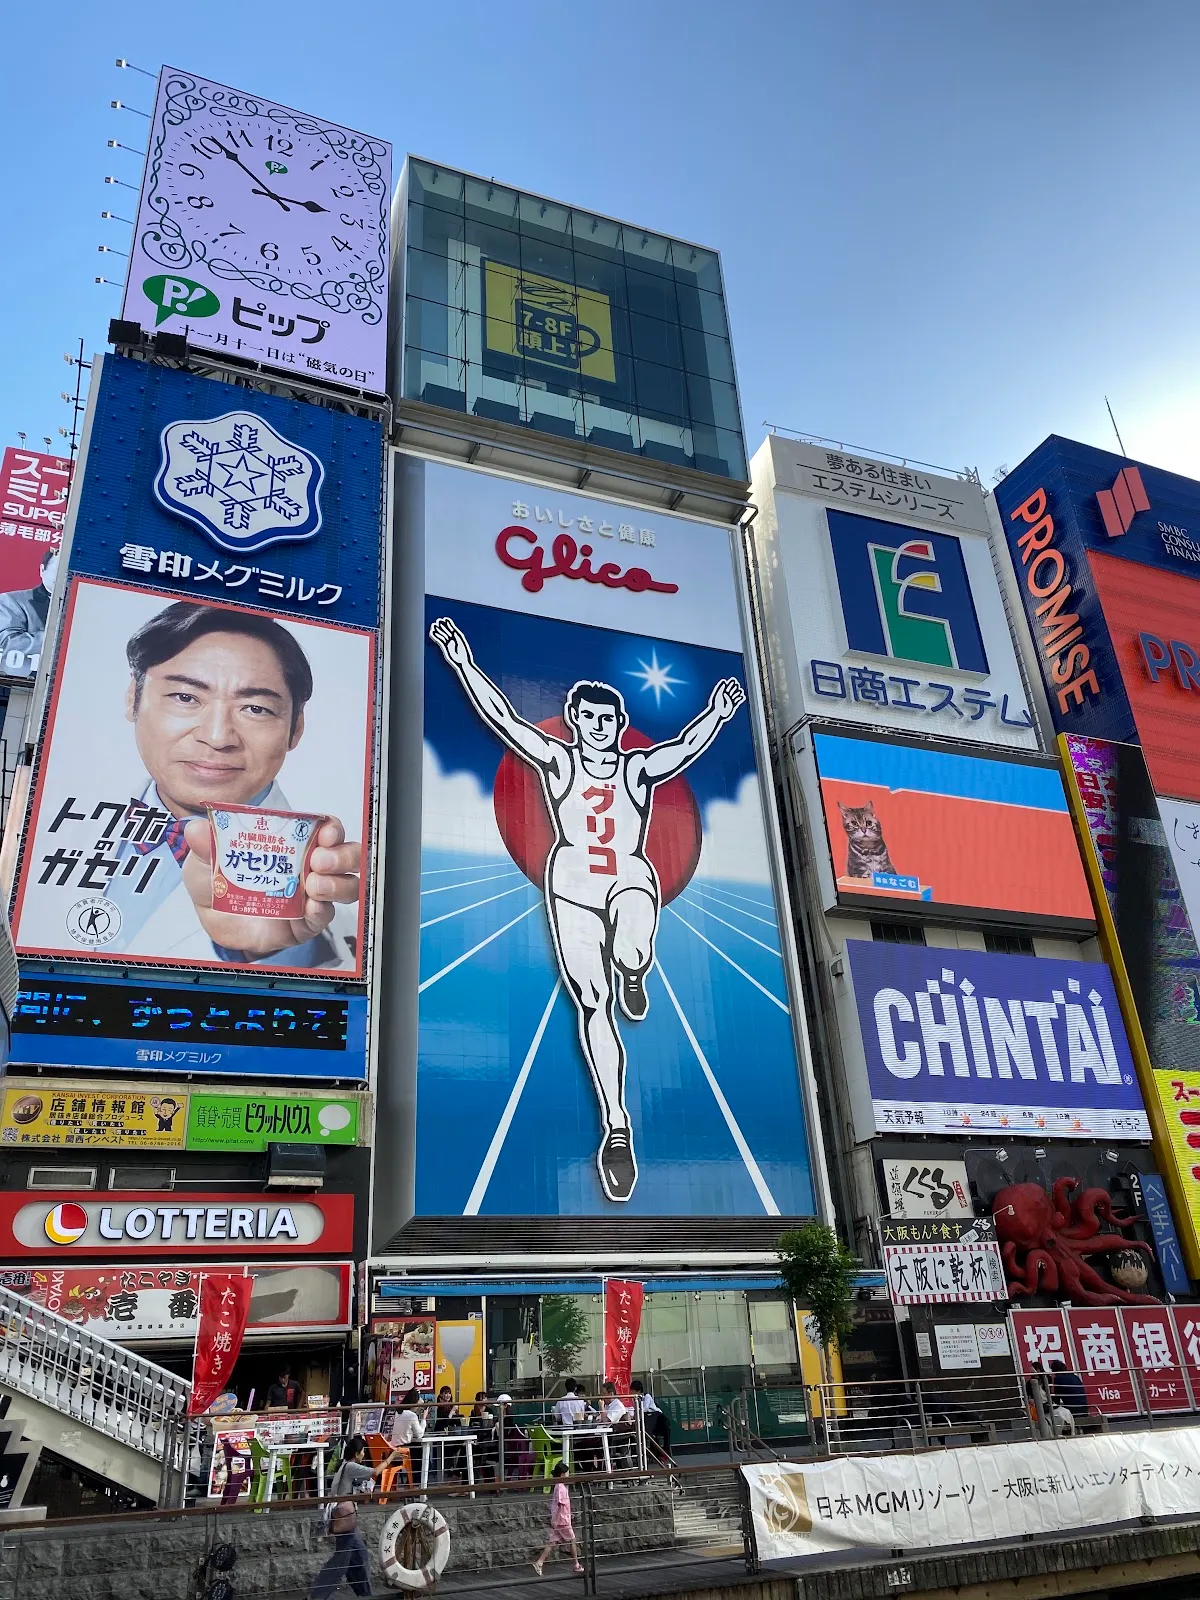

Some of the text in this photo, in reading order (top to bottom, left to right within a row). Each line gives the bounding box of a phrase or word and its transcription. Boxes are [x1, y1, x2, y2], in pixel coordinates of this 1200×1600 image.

[226, 129, 253, 148] 11
[263, 134, 294, 157] 12
[178, 162, 205, 180] 9
[309, 158, 324, 171] 1
[330, 185, 355, 198] 2
[186, 195, 214, 210] 8
[219, 222, 246, 238] 7
[339, 213, 364, 229] 3
[259, 242, 279, 261] 6
[330, 235, 353, 252] 4
[301, 245, 322, 266] 5
[231, 296, 331, 344] ピップ
[520, 310, 573, 337] 7-8F
[826, 453, 931, 491] 夢ある住まい
[813, 473, 956, 520] エステムシリーズ
[511, 499, 657, 548] おいしさと健康
[1157, 520, 1190, 539] SMBC
[496, 524, 680, 592] Glico
[119, 542, 343, 606] 雪印メグミルク
[1010, 487, 1100, 715] PROMISE
[0, 647, 41, 671] 01
[810, 659, 1034, 729] 日商エステム
[47, 796, 173, 846] トクホ
[254, 816, 270, 831] 恵
[581, 783, 618, 876] グリコ
[94, 839, 115, 851] の
[37, 847, 161, 895] ガセリ
[225, 849, 278, 873] ガセリ
[236, 872, 281, 886] ヨーグルト
[873, 966, 1124, 1086] CHINTAI
[135, 1048, 223, 1066] 雪印メグミルク
[48, 1112, 145, 1121] 居抜き店舗総合プロデュース
[50, 1098, 146, 1114] 店舗情報館
[196, 1105, 242, 1129] 賃貸・売買
[245, 1102, 312, 1135] ピタットハウス
[882, 1109, 925, 1125] 天気予報
[21, 1133, 125, 1145] 株式会社 関西インベスト
[902, 1166, 955, 1210] くくる
[99, 1207, 300, 1240] LOTTERIA
[883, 1222, 963, 1241] 大阪もんを食す
[979, 1231, 994, 1242] 2F
[120, 1270, 191, 1288] たこやき
[894, 1253, 988, 1294] 大阪に乾杯
[210, 1287, 237, 1375] たこ焼き
[616, 1289, 633, 1362] たこ焼き
[415, 1370, 430, 1387] 8F
[1098, 1387, 1121, 1400] Visa
[1150, 1382, 1176, 1398] カード
[816, 1482, 977, 1521] 日本MGMリゾーツ
[1004, 1462, 1200, 1500] 大阪に新しいエンターテインメ
